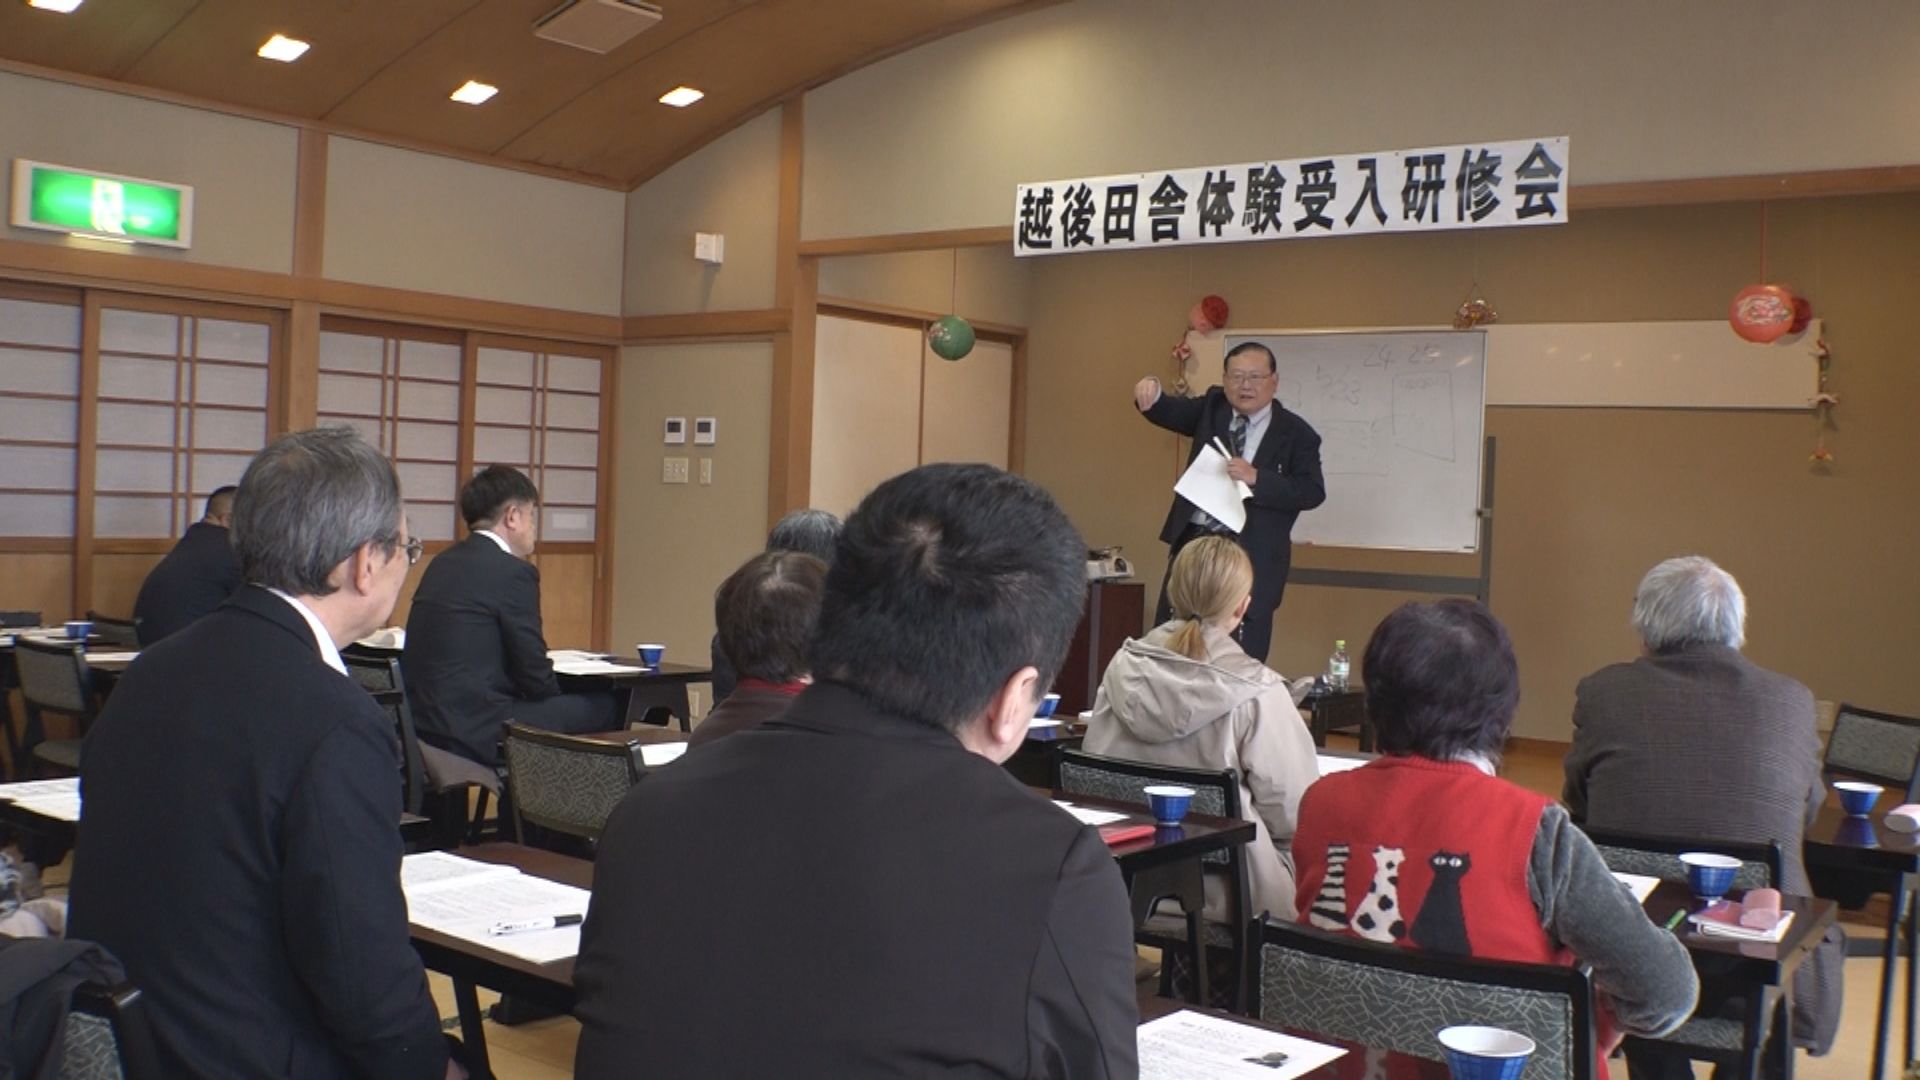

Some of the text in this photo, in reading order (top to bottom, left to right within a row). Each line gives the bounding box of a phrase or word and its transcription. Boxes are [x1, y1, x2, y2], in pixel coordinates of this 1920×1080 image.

[1018, 142, 1563, 250] 越後田舎体験受入研修会
